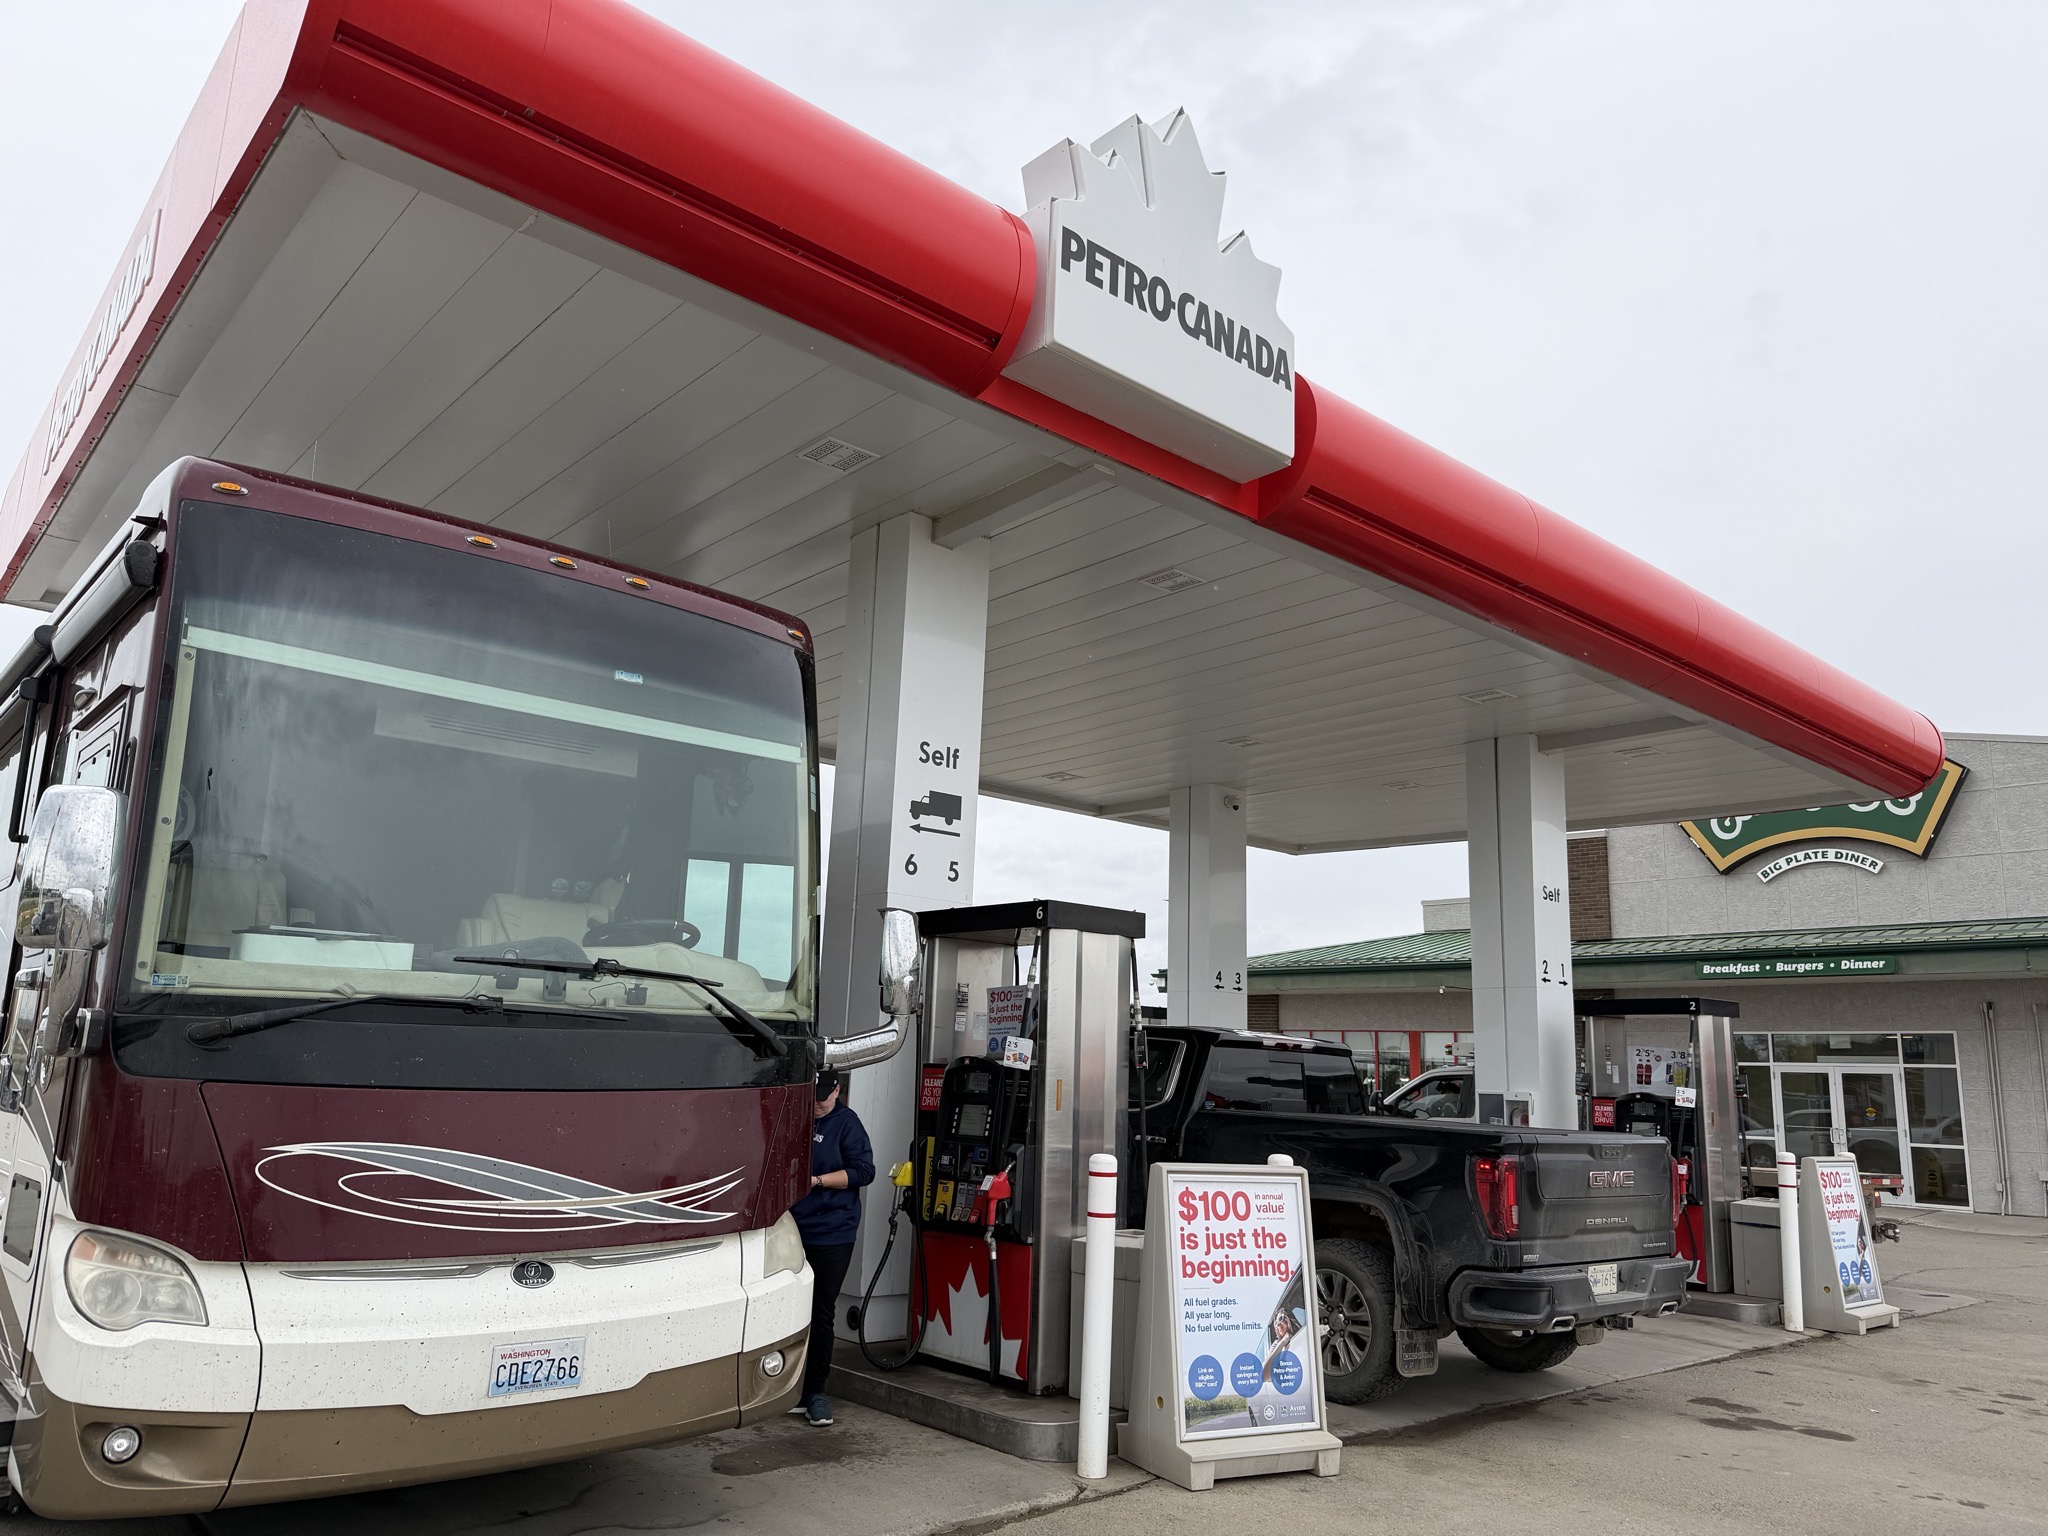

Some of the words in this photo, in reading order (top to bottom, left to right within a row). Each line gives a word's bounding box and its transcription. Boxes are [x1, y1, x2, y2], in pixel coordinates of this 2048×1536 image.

[1060, 225, 1292, 392] PETRO-CANADA
[919, 741, 960, 769] Self
[904, 853, 918, 875] 6
[947, 861, 959, 882] 5
[1760, 862, 1783, 880] BIG
[1785, 850, 1829, 866] PLATE
[1834, 851, 1879, 871] DINER
[1542, 885, 1560, 903] Self
[1036, 906, 1043, 919] 6
[1542, 960, 1549, 974] 2
[1560, 963, 1565, 977] 1
[1703, 963, 1760, 974] Breakfast
[1776, 961, 1824, 973] Burgers
[1841, 959, 1885, 970] Dinner
[1215, 970, 1222, 983] 4
[1235, 972, 1241, 984] 3
[990, 990, 1012, 1004] $100
[989, 1004, 994, 1014] is
[996, 1004, 1008, 1015] just
[1011, 1003, 1022, 1012] the
[1690, 1002, 1696, 1010] 2
[924, 1087, 932, 1096] AS
[1589, 1171, 1635, 1187] GMC
[1820, 1170, 1842, 1191] $100
[1178, 1187, 1251, 1225] $100
[1830, 1192, 1844, 1208] just
[1844, 1191, 1855, 1203] the
[1586, 1217, 1628, 1225] DENALI
[1180, 1226, 1199, 1250] is
[1205, 1226, 1246, 1256] just
[1252, 1226, 1287, 1249] the
[1182, 1254, 1295, 1284] beginning.
[1184, 1298, 1193, 1306] All
[1195, 1298, 1209, 1306] fuel
[1211, 1298, 1238, 1308] grades.
[1185, 1311, 1194, 1319] All
[1196, 1313, 1212, 1321] year
[1213, 1311, 1232, 1320] long.
[1185, 1324, 1196, 1332] No
[1198, 1324, 1212, 1332] fuel
[1213, 1323, 1240, 1331] volume
[1242, 1322, 1263, 1330] limits.
[501, 1349, 551, 1360] WASHINGTON
[496, 1356, 579, 1388] CDE2766
